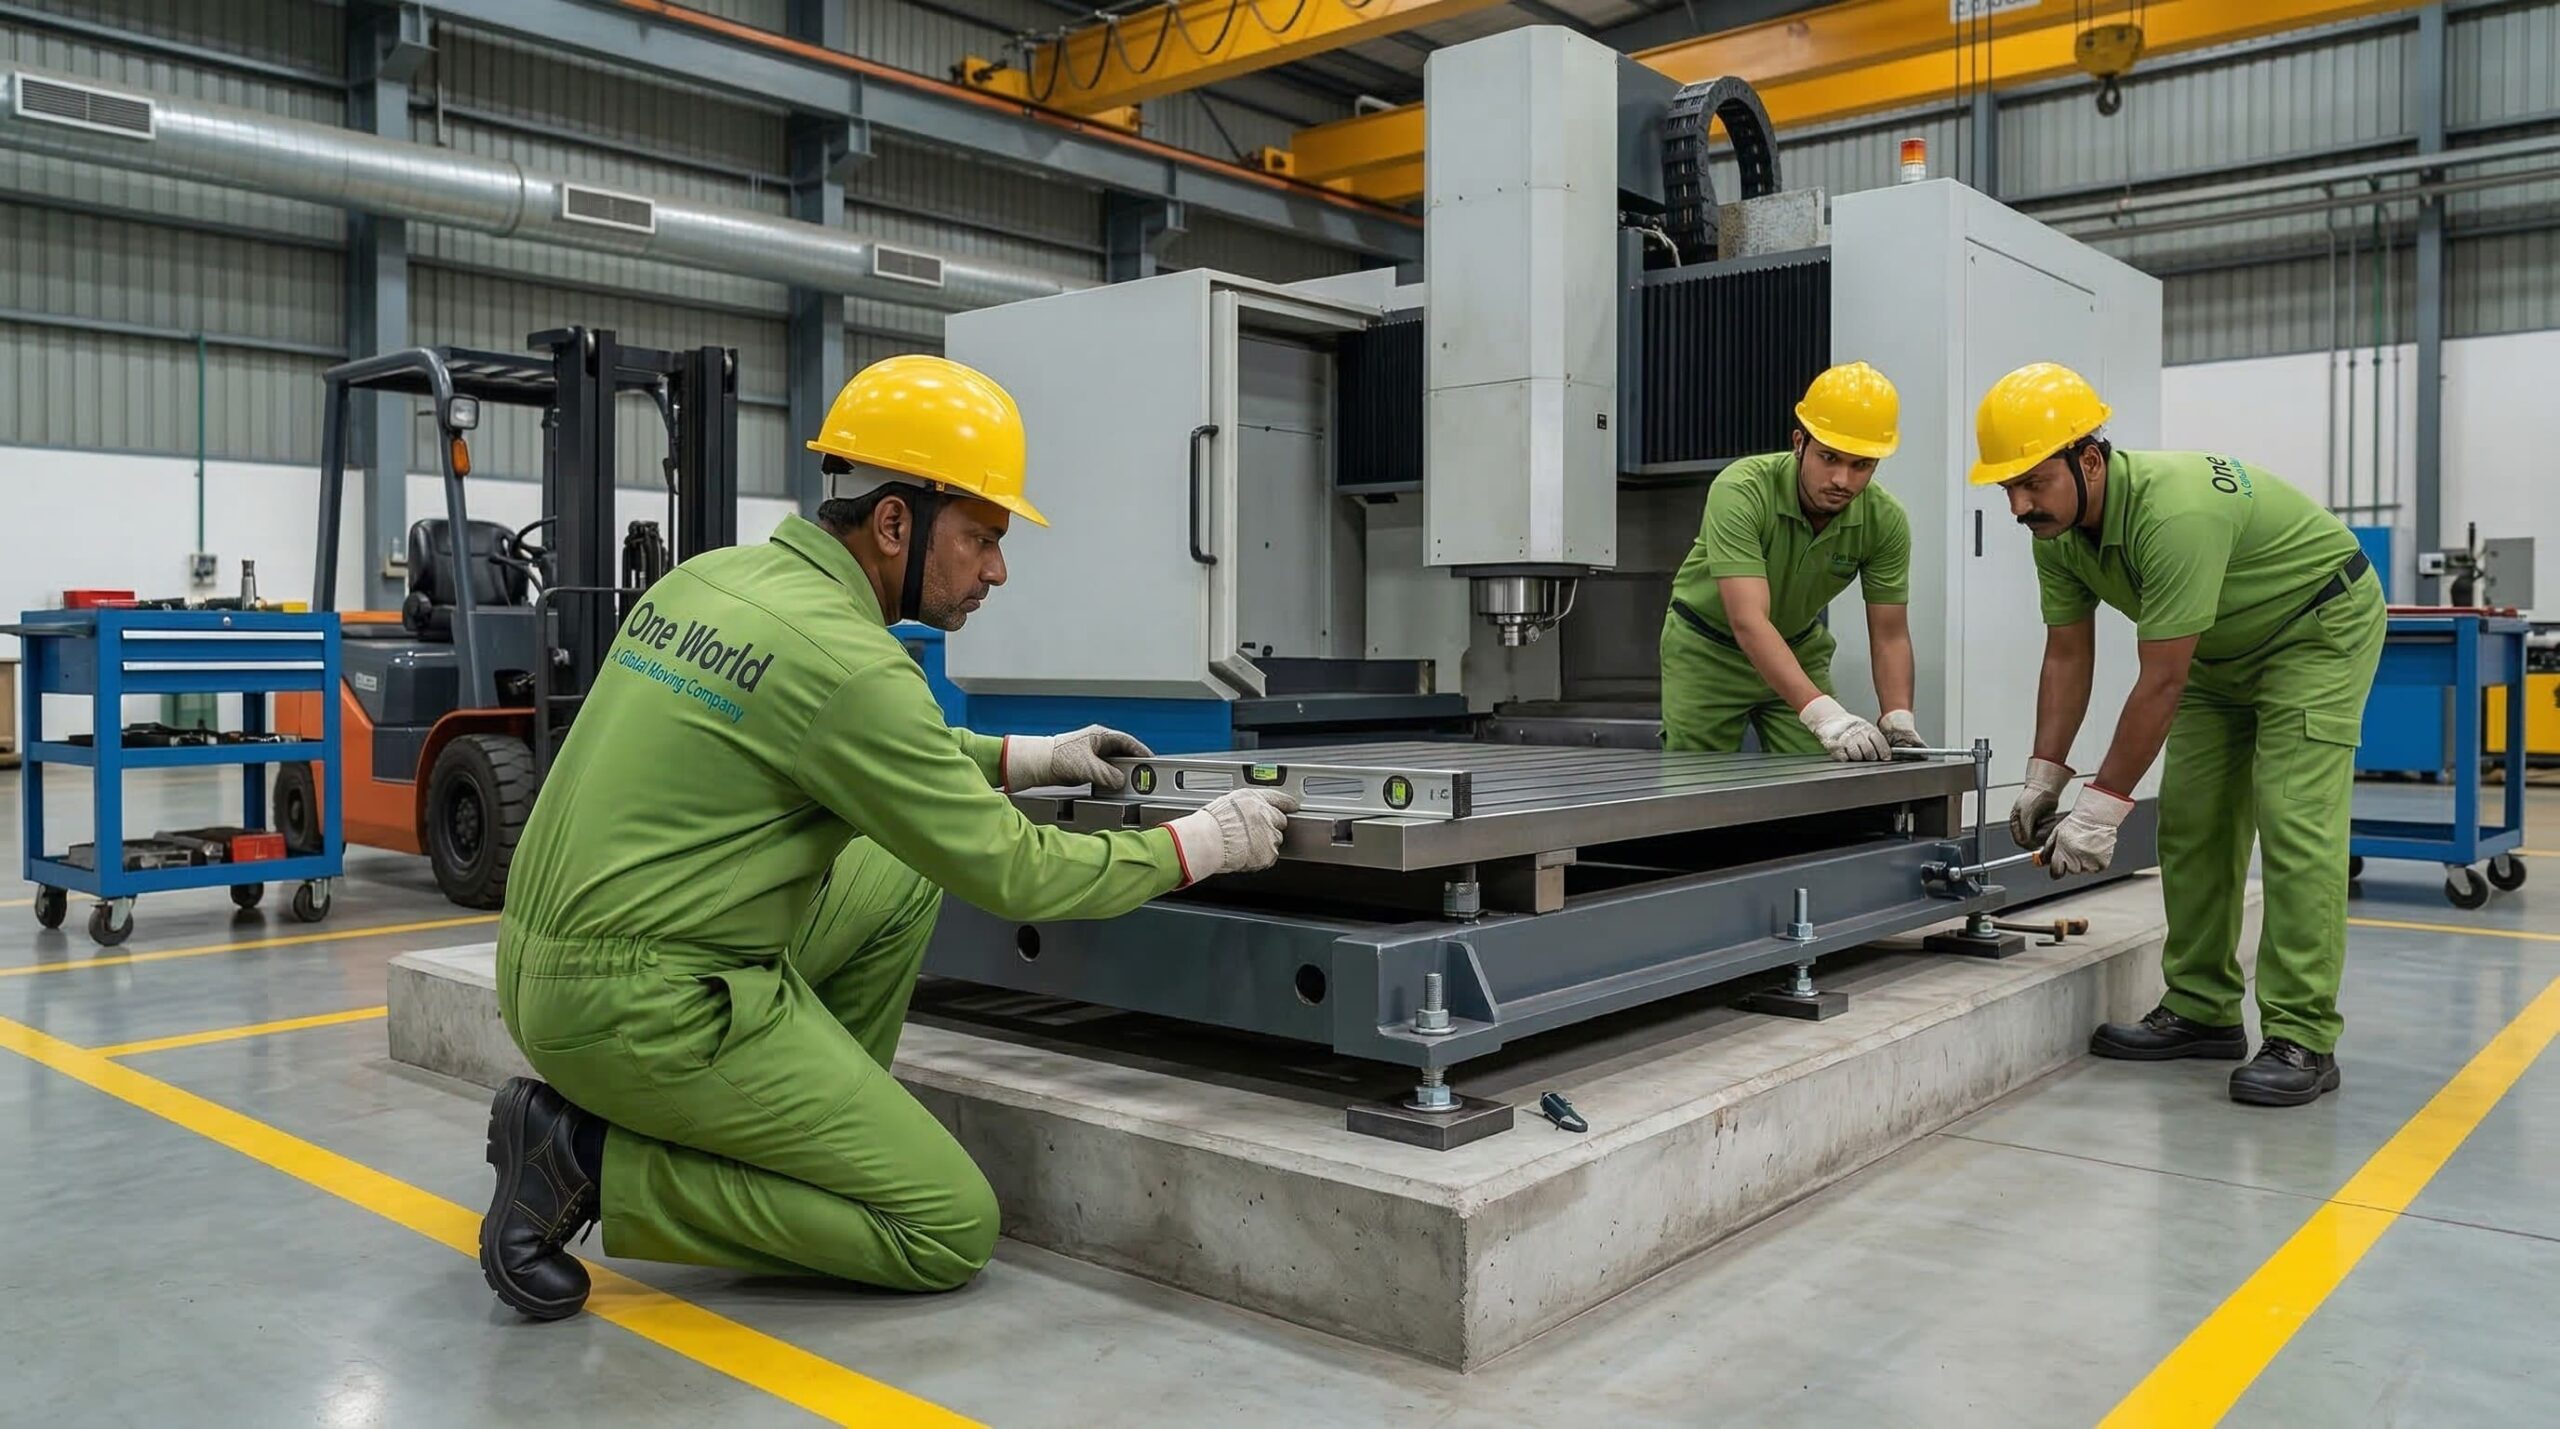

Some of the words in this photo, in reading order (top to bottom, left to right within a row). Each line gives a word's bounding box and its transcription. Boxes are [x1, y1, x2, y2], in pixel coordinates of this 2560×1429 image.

[2205, 456, 2238, 493] One
[627, 601, 678, 649] One
[675, 620, 774, 693] World
[611, 649, 621, 661] A
[648, 661, 686, 694] Moving
[686, 679, 744, 724] Company
